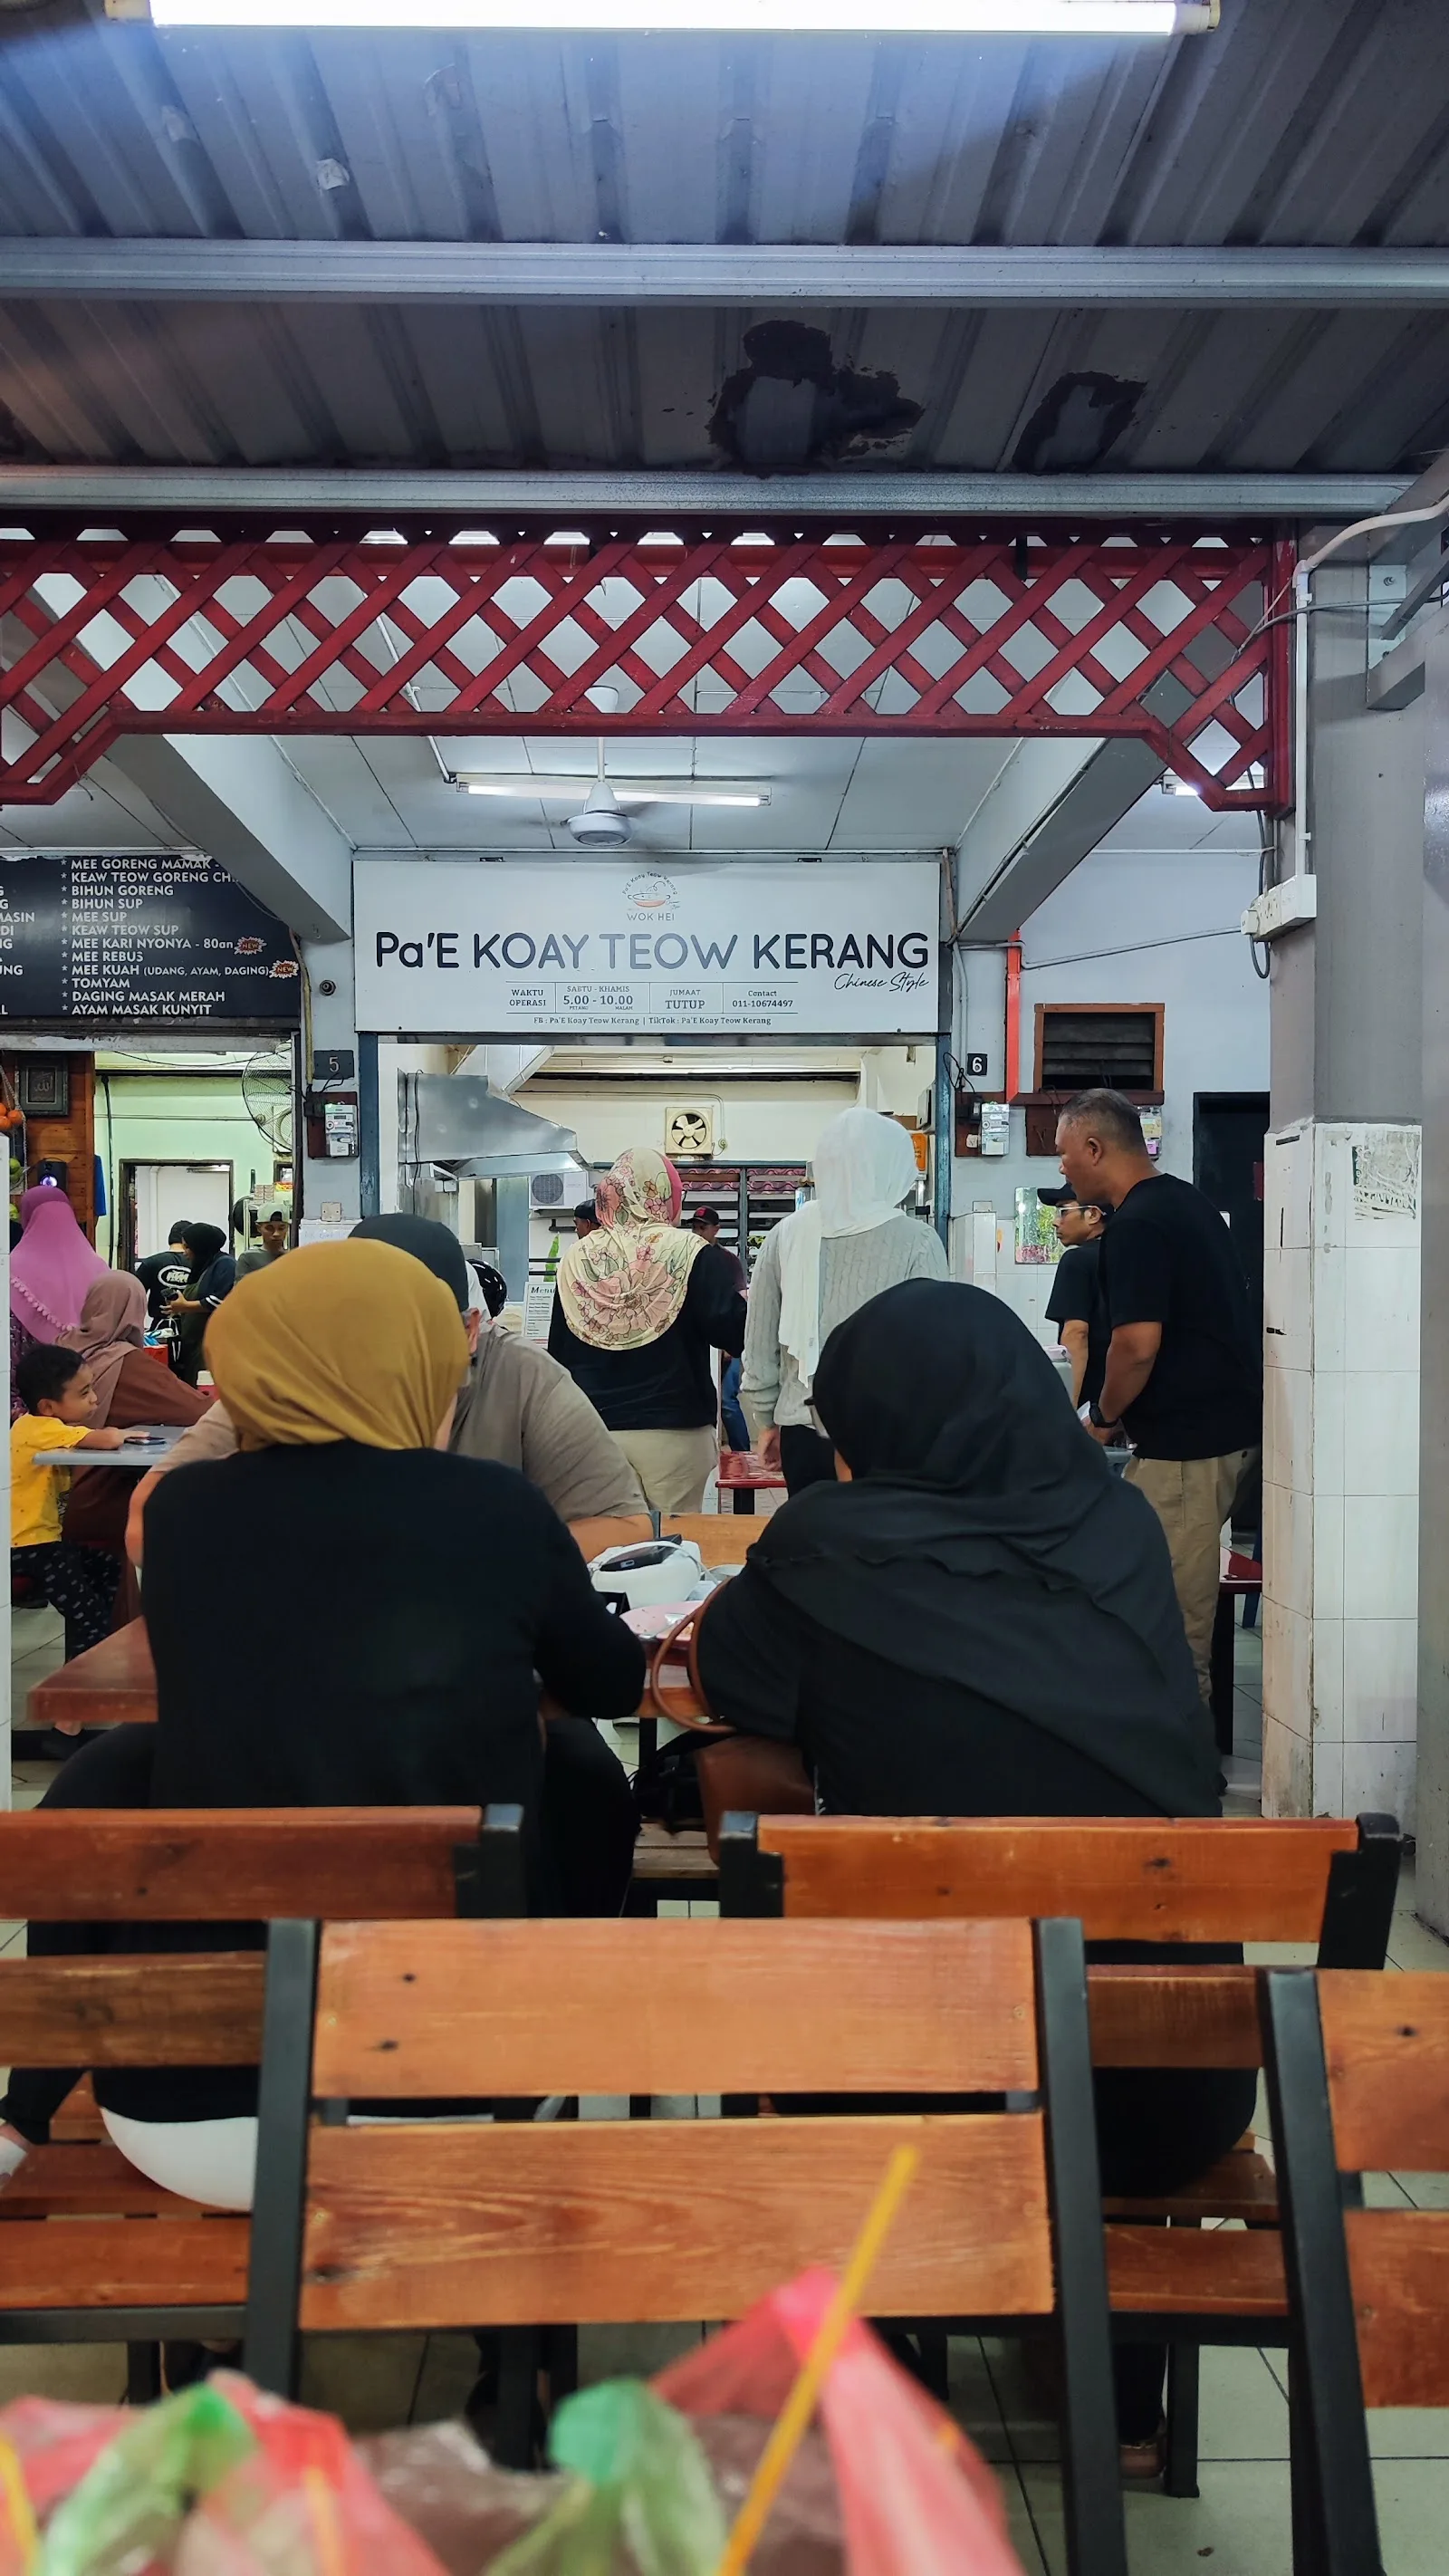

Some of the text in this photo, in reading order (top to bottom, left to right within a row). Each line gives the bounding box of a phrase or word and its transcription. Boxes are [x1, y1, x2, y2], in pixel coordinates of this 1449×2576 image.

[71, 859, 98, 870] MEE
[101, 859, 158, 870] GORENG
[161, 860, 211, 870] MAMAK
[72, 871, 107, 883] KEAW
[110, 871, 149, 883] TEOW
[153, 871, 208, 883] GORENG
[72, 885, 174, 896] BIHUN GORENG
[72, 899, 143, 909] BIHUN SUP
[72, 911, 128, 923] MEE SUP
[627, 912, 675, 921] WOK HEI
[72, 925, 178, 936] KEAW TEOW SUP
[72, 938, 98, 949] MEE
[102, 938, 132, 949] KARI
[137, 938, 192, 949] NYONYA
[203, 938, 234, 949] 80an
[242, 940, 259, 948] NEW
[376, 932, 929, 969] Pa'E KOAY TEOW KERANG
[72, 951, 144, 962] MEE REBUS
[72, 965, 98, 976] MEE
[102, 965, 139, 976] KUAH
[143, 966, 187, 976] (UDANG,
[190, 966, 222, 976] AYAM,
[276, 966, 293, 974] NEW
[72, 978, 130, 988] TOMYAM
[834, 971, 930, 993] Chinese Style
[72, 991, 226, 1002] DAGING MASAK MERAH
[563, 995, 590, 1005] 5.00
[600, 995, 633, 1005] 10.00
[72, 1004, 212, 1015] AYAM MASAK KUNYIT
[665, 1000, 705, 1009] TUTUP
[610, 1017, 639, 1025] Kerang
[699, 1017, 719, 1025] Koay
[743, 1017, 772, 1025] Kerang
[329, 1056, 340, 1072] 5
[972, 1056, 983, 1073] 6
